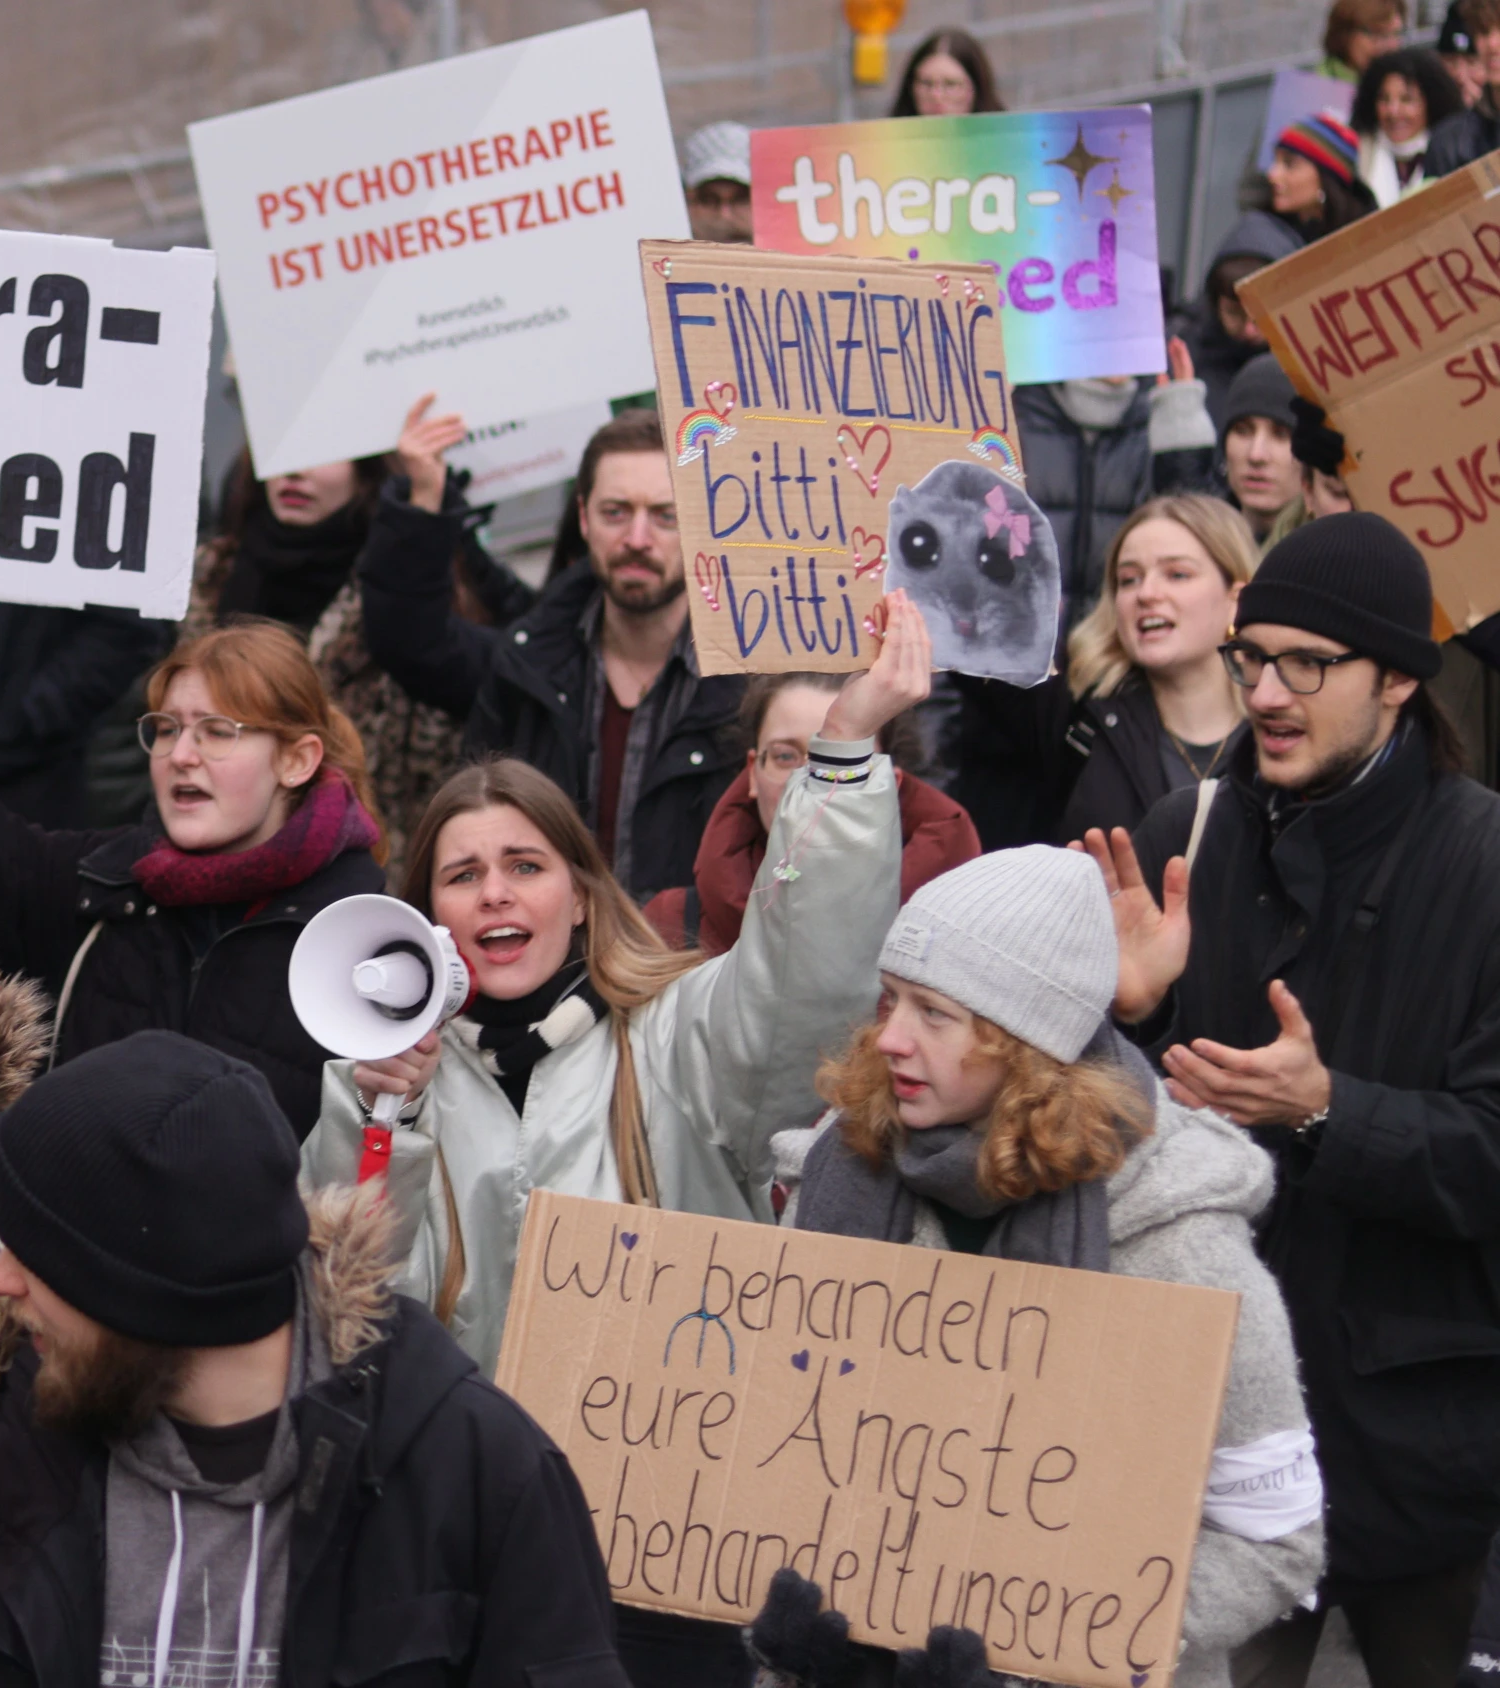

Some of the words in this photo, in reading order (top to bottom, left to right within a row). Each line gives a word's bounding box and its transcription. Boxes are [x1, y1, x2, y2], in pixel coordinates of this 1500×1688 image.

[257, 108, 615, 230] PSYCHOTHERAPIE
[776, 152, 1061, 245] thera-
[270, 243, 325, 290] IST
[337, 171, 626, 273] UNERSETZLICH
[703, 440, 847, 544] bitti
[721, 554, 859, 658] bitti
[542, 1215, 676, 1305] Wir
[703, 1232, 1050, 1379] behandeln
[581, 1374, 736, 1460] eure
[757, 1349, 1078, 1553] Ängste
[927, 1556, 1173, 1672] unsere?
